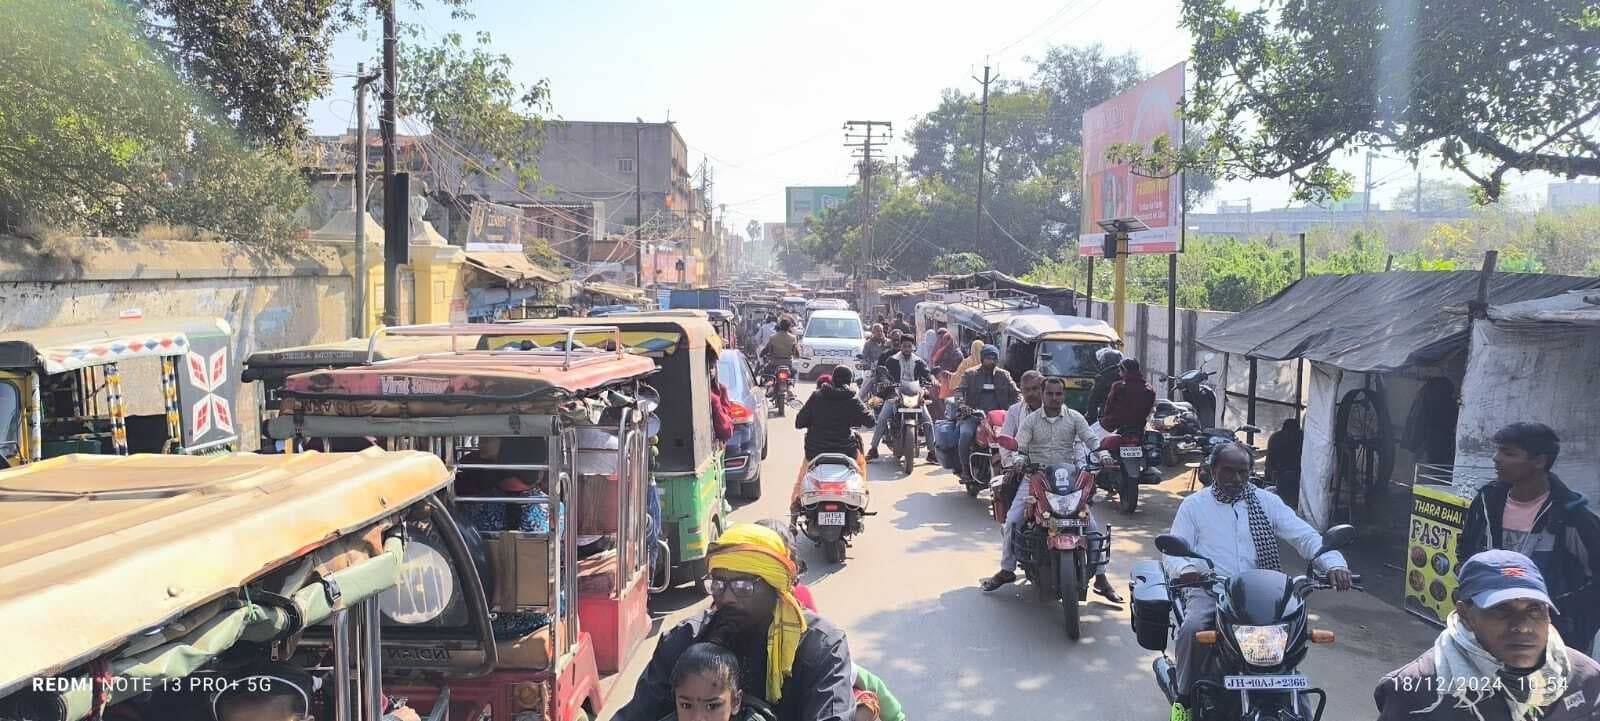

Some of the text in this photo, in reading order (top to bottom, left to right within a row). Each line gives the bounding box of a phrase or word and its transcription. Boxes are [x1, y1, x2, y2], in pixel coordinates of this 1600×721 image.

[1414, 499, 1463, 524] THARA BHAI
[1410, 518, 1452, 550] FAST
